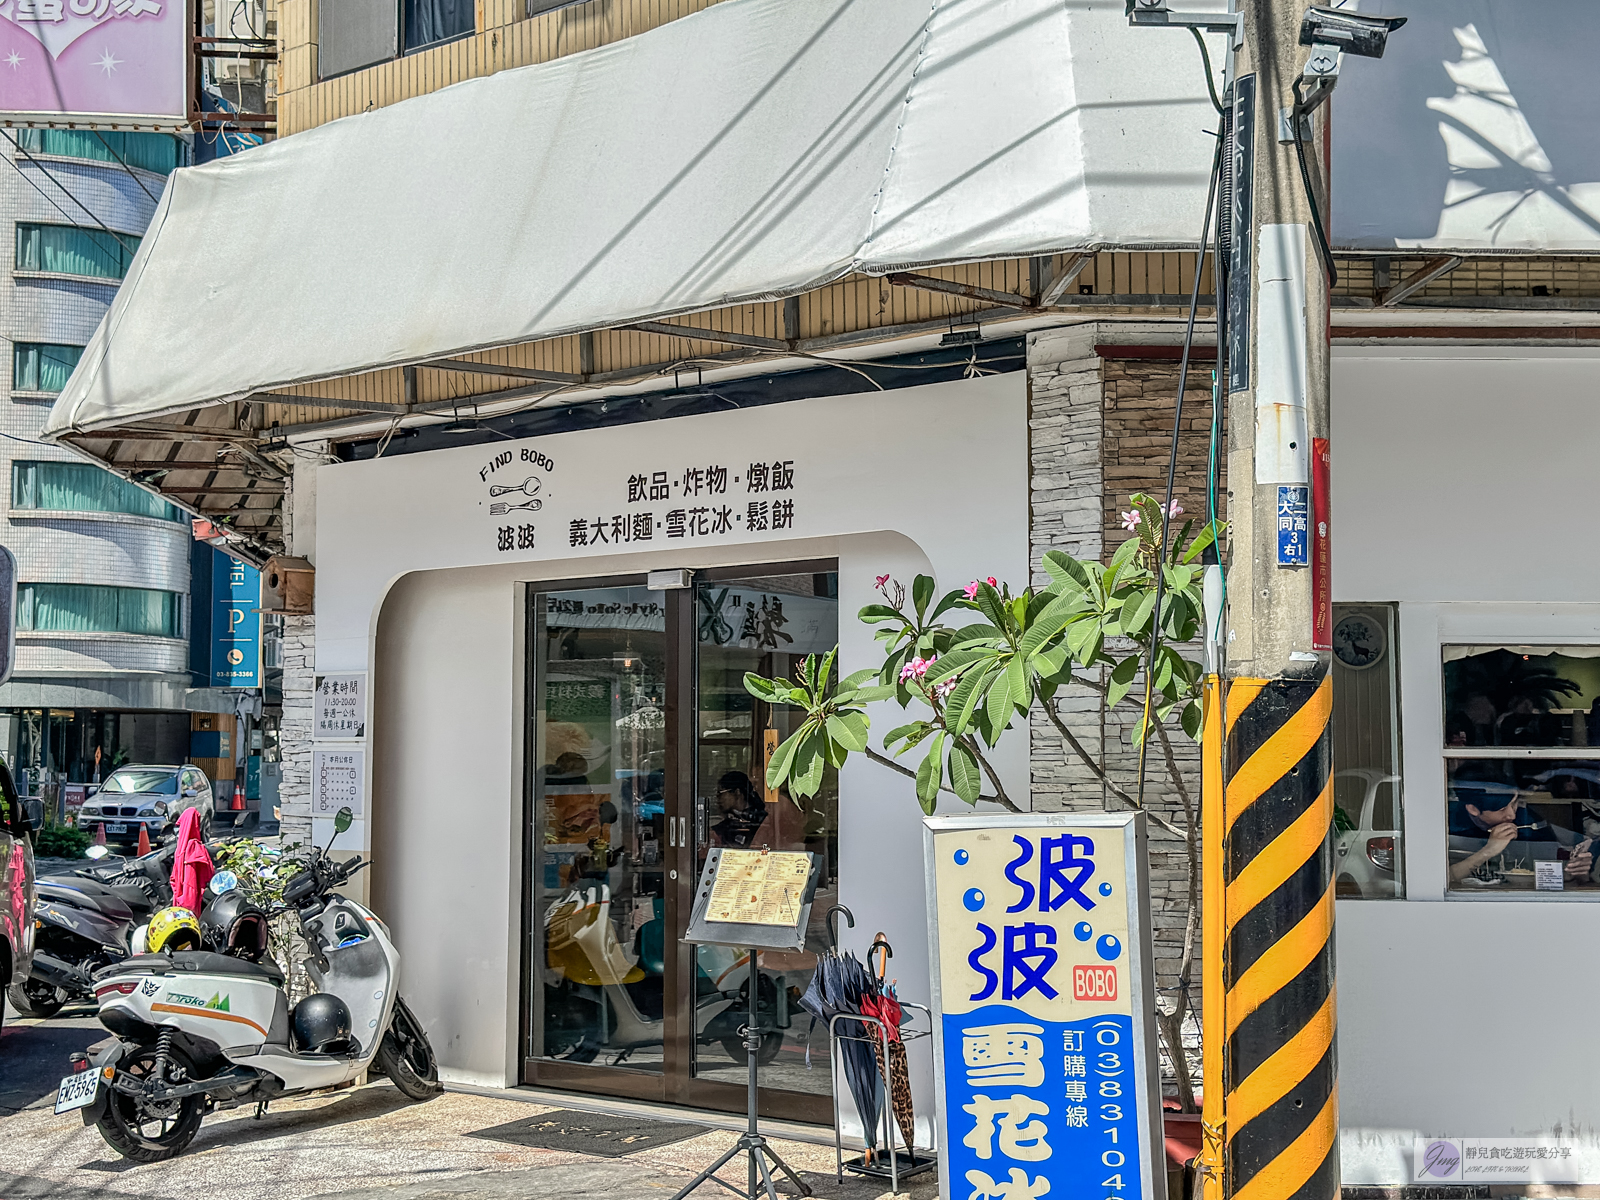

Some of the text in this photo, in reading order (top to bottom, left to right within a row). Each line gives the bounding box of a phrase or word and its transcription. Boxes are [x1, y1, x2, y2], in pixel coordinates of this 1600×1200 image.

[479, 448, 554, 482] FIND BOBO
[498, 523, 535, 551] 波波
[228, 609, 245, 633] P
[323, 681, 358, 695] 營業時間
[1074, 968, 1117, 999] BOBO
[1062, 1029, 1089, 1128] 訂購專線
[1092, 1021, 1127, 1199] (03)83104
